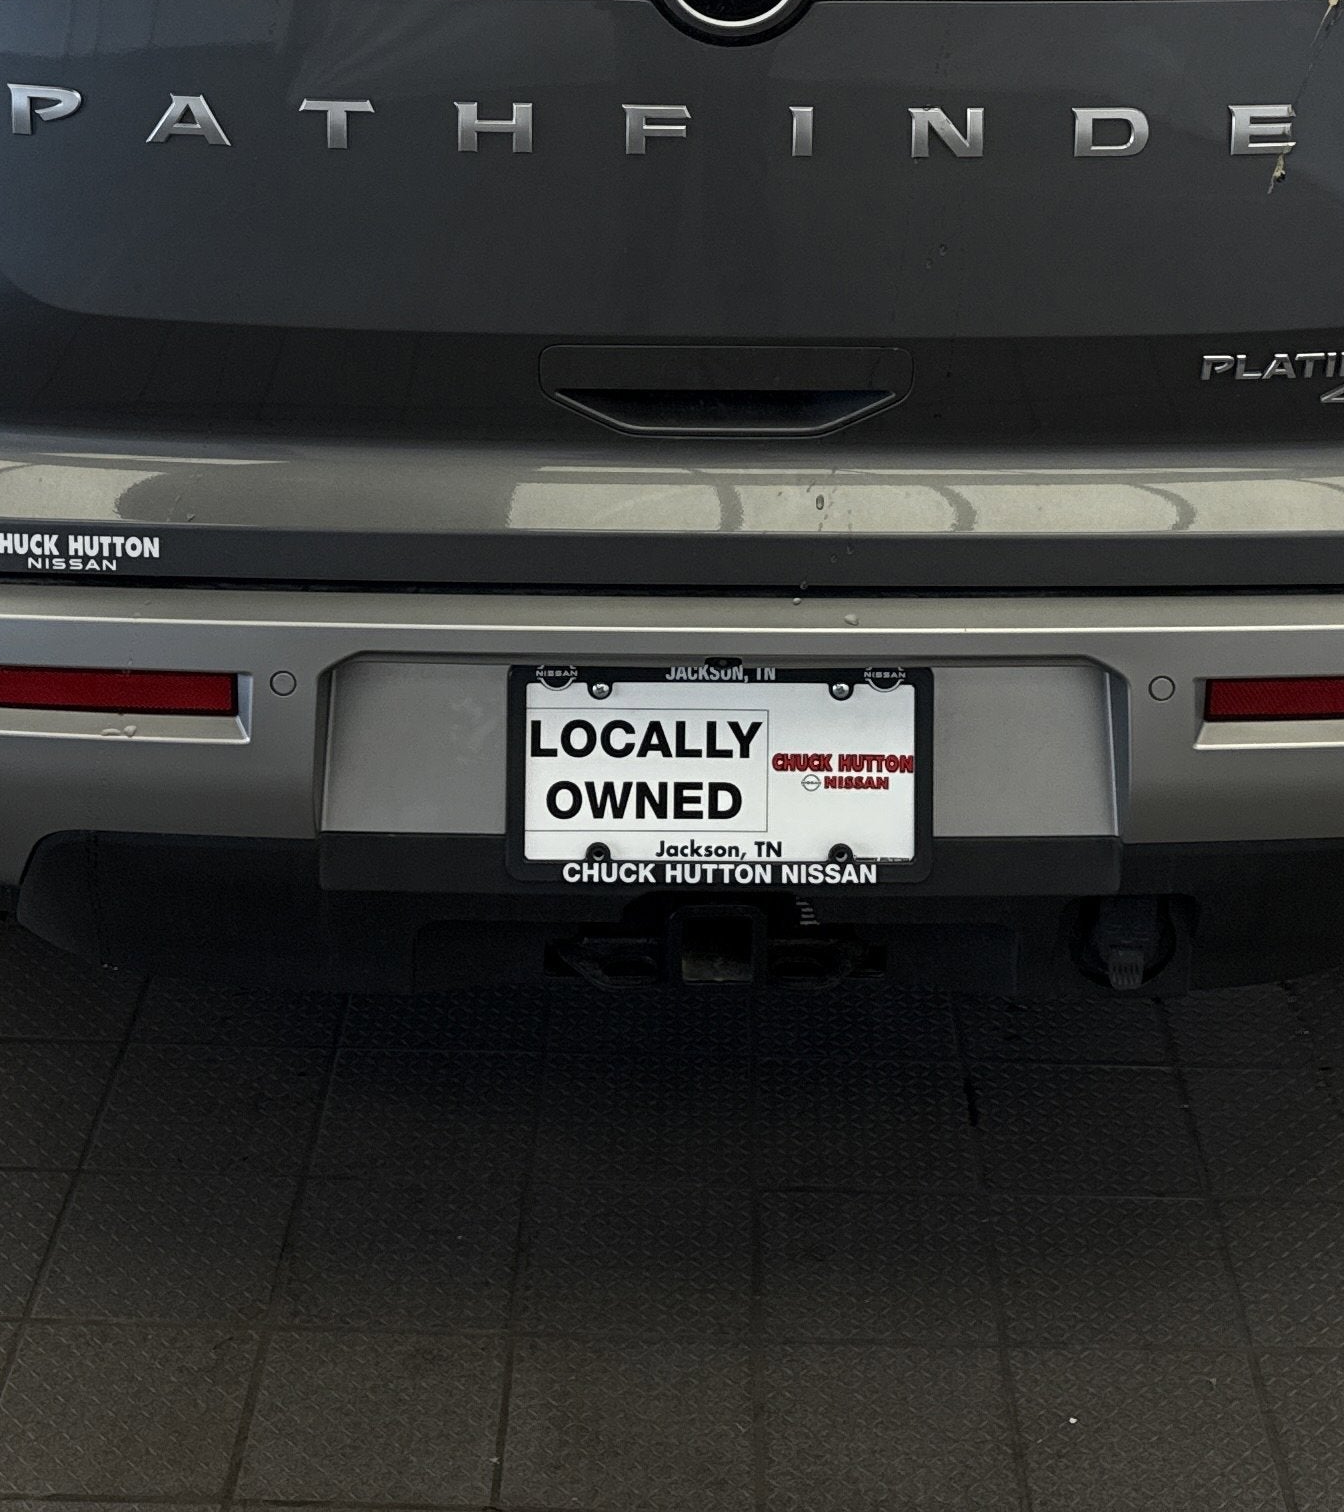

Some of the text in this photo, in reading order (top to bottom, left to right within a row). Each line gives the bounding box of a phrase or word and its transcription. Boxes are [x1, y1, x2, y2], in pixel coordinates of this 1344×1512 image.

[68, 535, 160, 558] HUTTON
[27, 557, 117, 571] NISSAN
[665, 664, 749, 683] JACKSON,
[530, 719, 762, 759] LOCALLY
[772, 753, 914, 773] CHUCK HUTTON
[824, 776, 889, 790] NISSAN
[546, 780, 743, 821] OWNED
[655, 839, 783, 860] Jackson, TN
[562, 862, 877, 885] CHUCK HUTTON NISSAN
